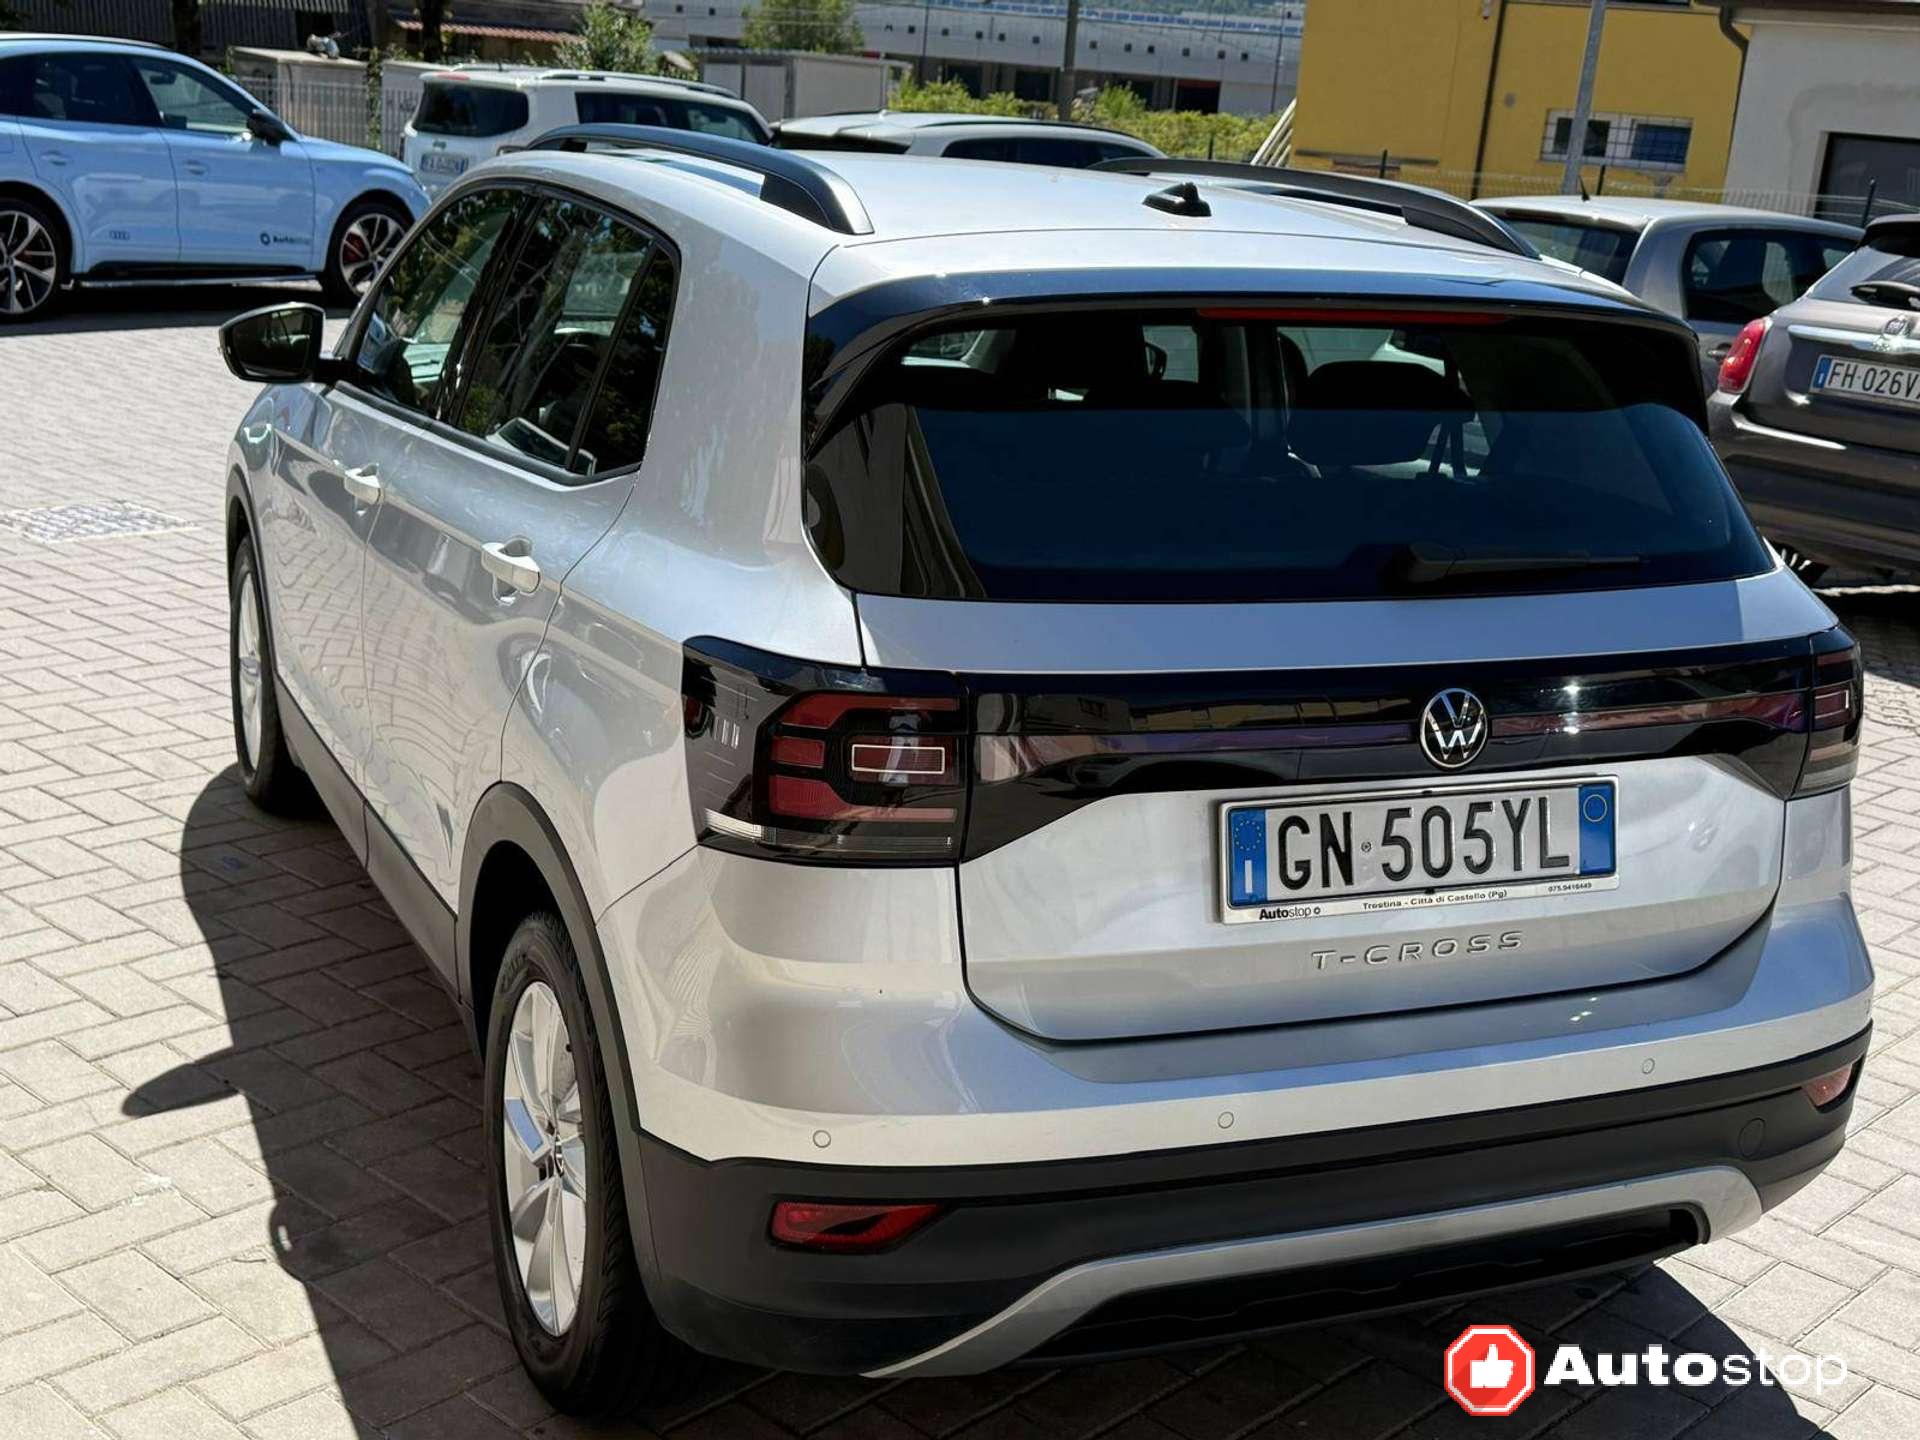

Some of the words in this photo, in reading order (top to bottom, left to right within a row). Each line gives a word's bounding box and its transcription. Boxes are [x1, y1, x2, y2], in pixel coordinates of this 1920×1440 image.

[1828, 362, 1858, 389] FH
[1862, 367, 1920, 400] 026V
[1277, 811, 1354, 891] GN
[1380, 796, 1571, 882] 505YL
[1244, 859, 1254, 894] I
[1259, 906, 1312, 921] Autostop
[1435, 895, 1445, 904] di
[1310, 930, 1524, 971] T-CROSS
